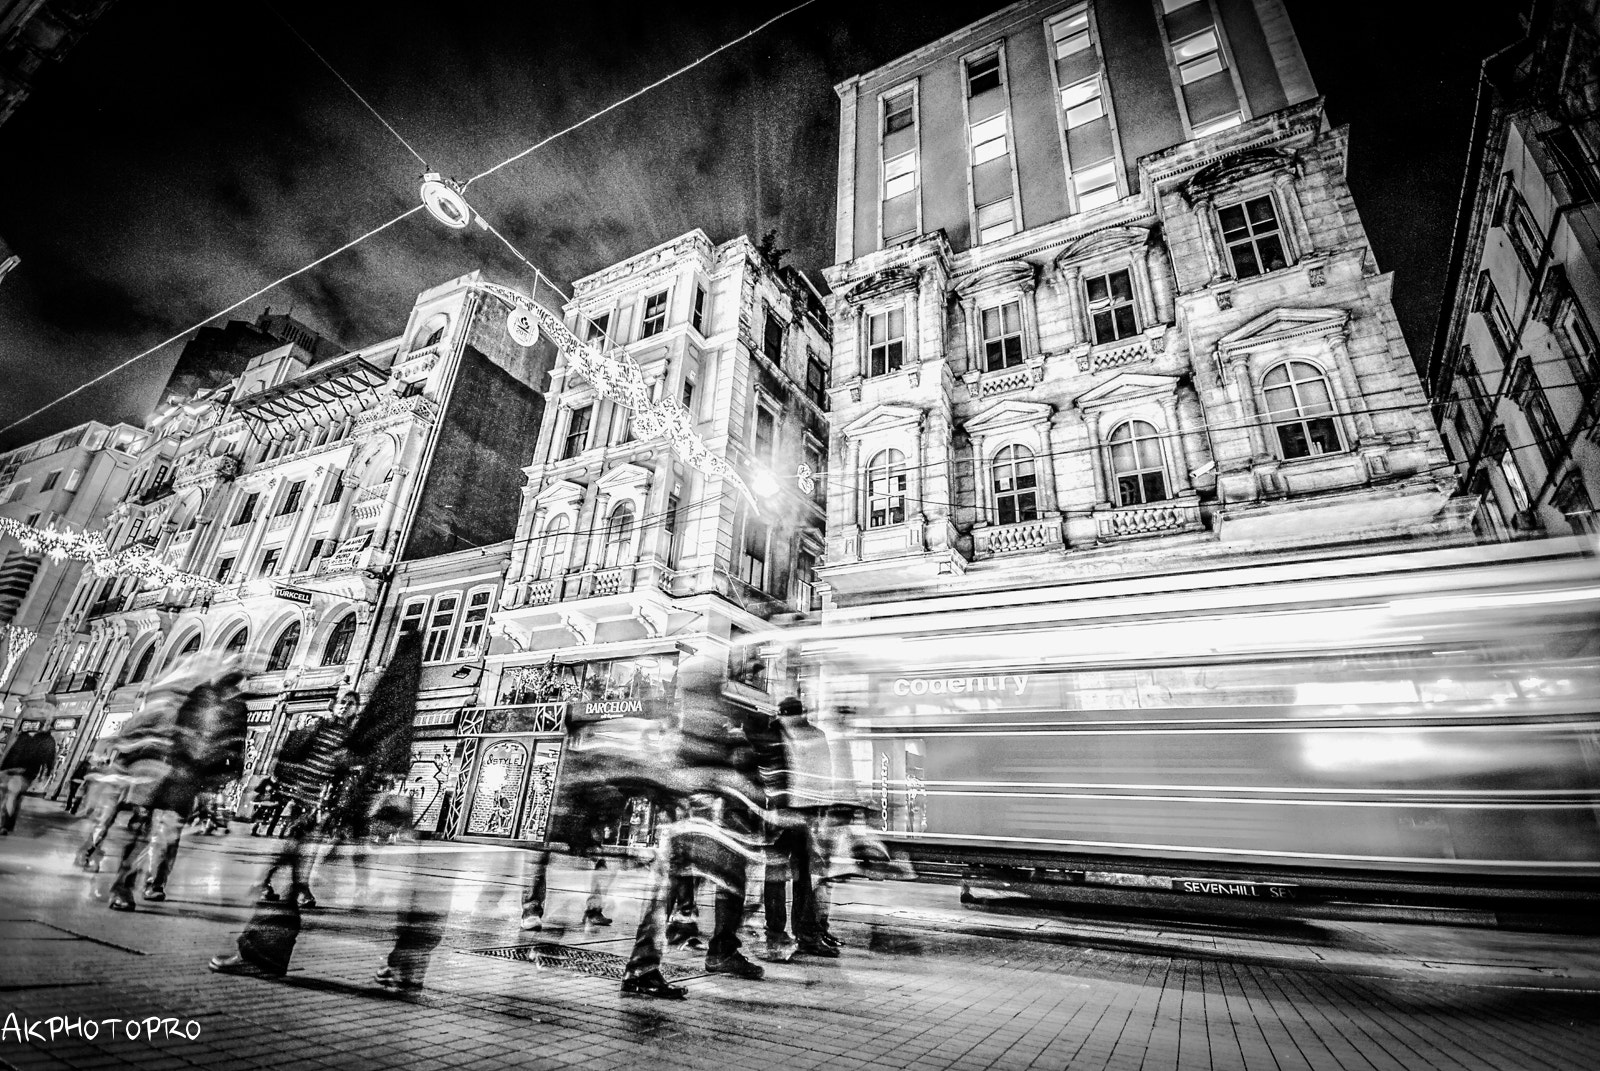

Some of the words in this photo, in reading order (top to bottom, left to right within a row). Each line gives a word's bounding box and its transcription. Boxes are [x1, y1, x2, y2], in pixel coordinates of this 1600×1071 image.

[275, 589, 310, 602] TURKCELL
[585, 700, 642, 714] BARCELONA
[1184, 881, 1260, 897] SEVENHILL
